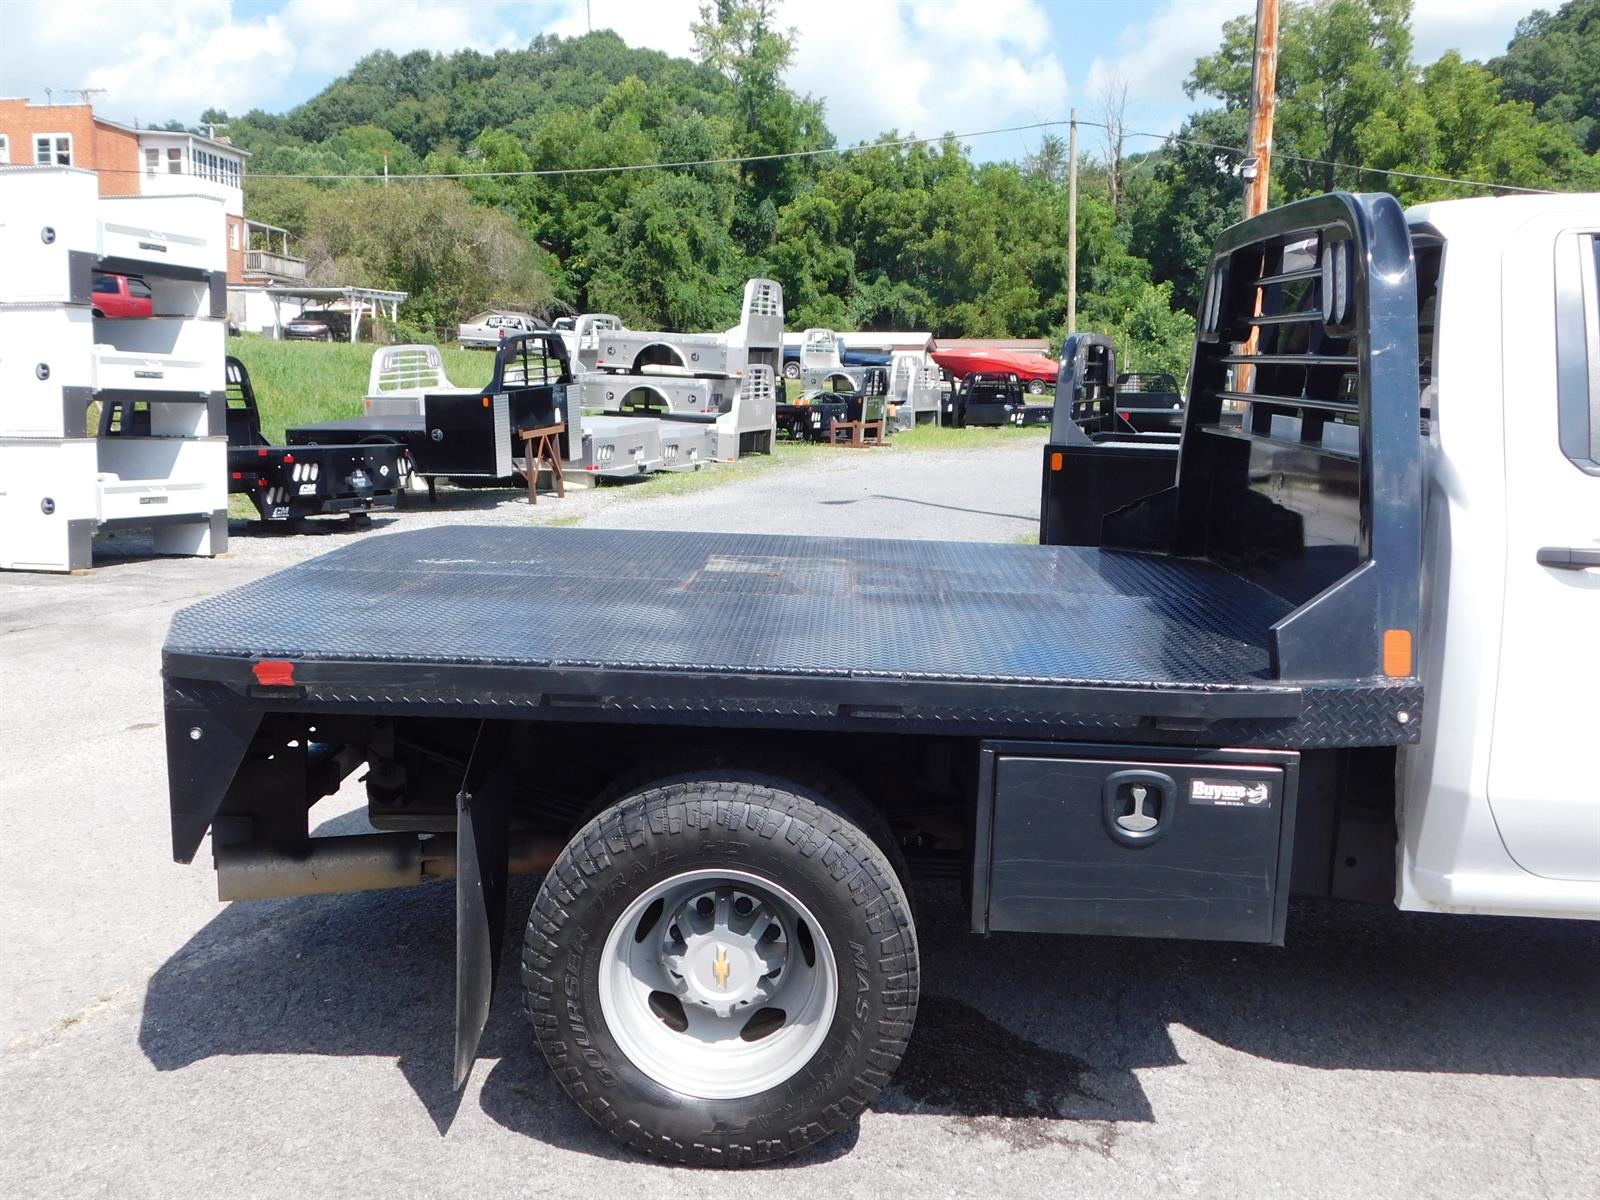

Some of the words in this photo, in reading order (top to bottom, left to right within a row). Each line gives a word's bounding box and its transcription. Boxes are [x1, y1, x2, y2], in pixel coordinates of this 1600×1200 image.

[299, 484, 317, 492] CM
[273, 506, 290, 516] CM
[1192, 781, 1247, 799] Buyers
